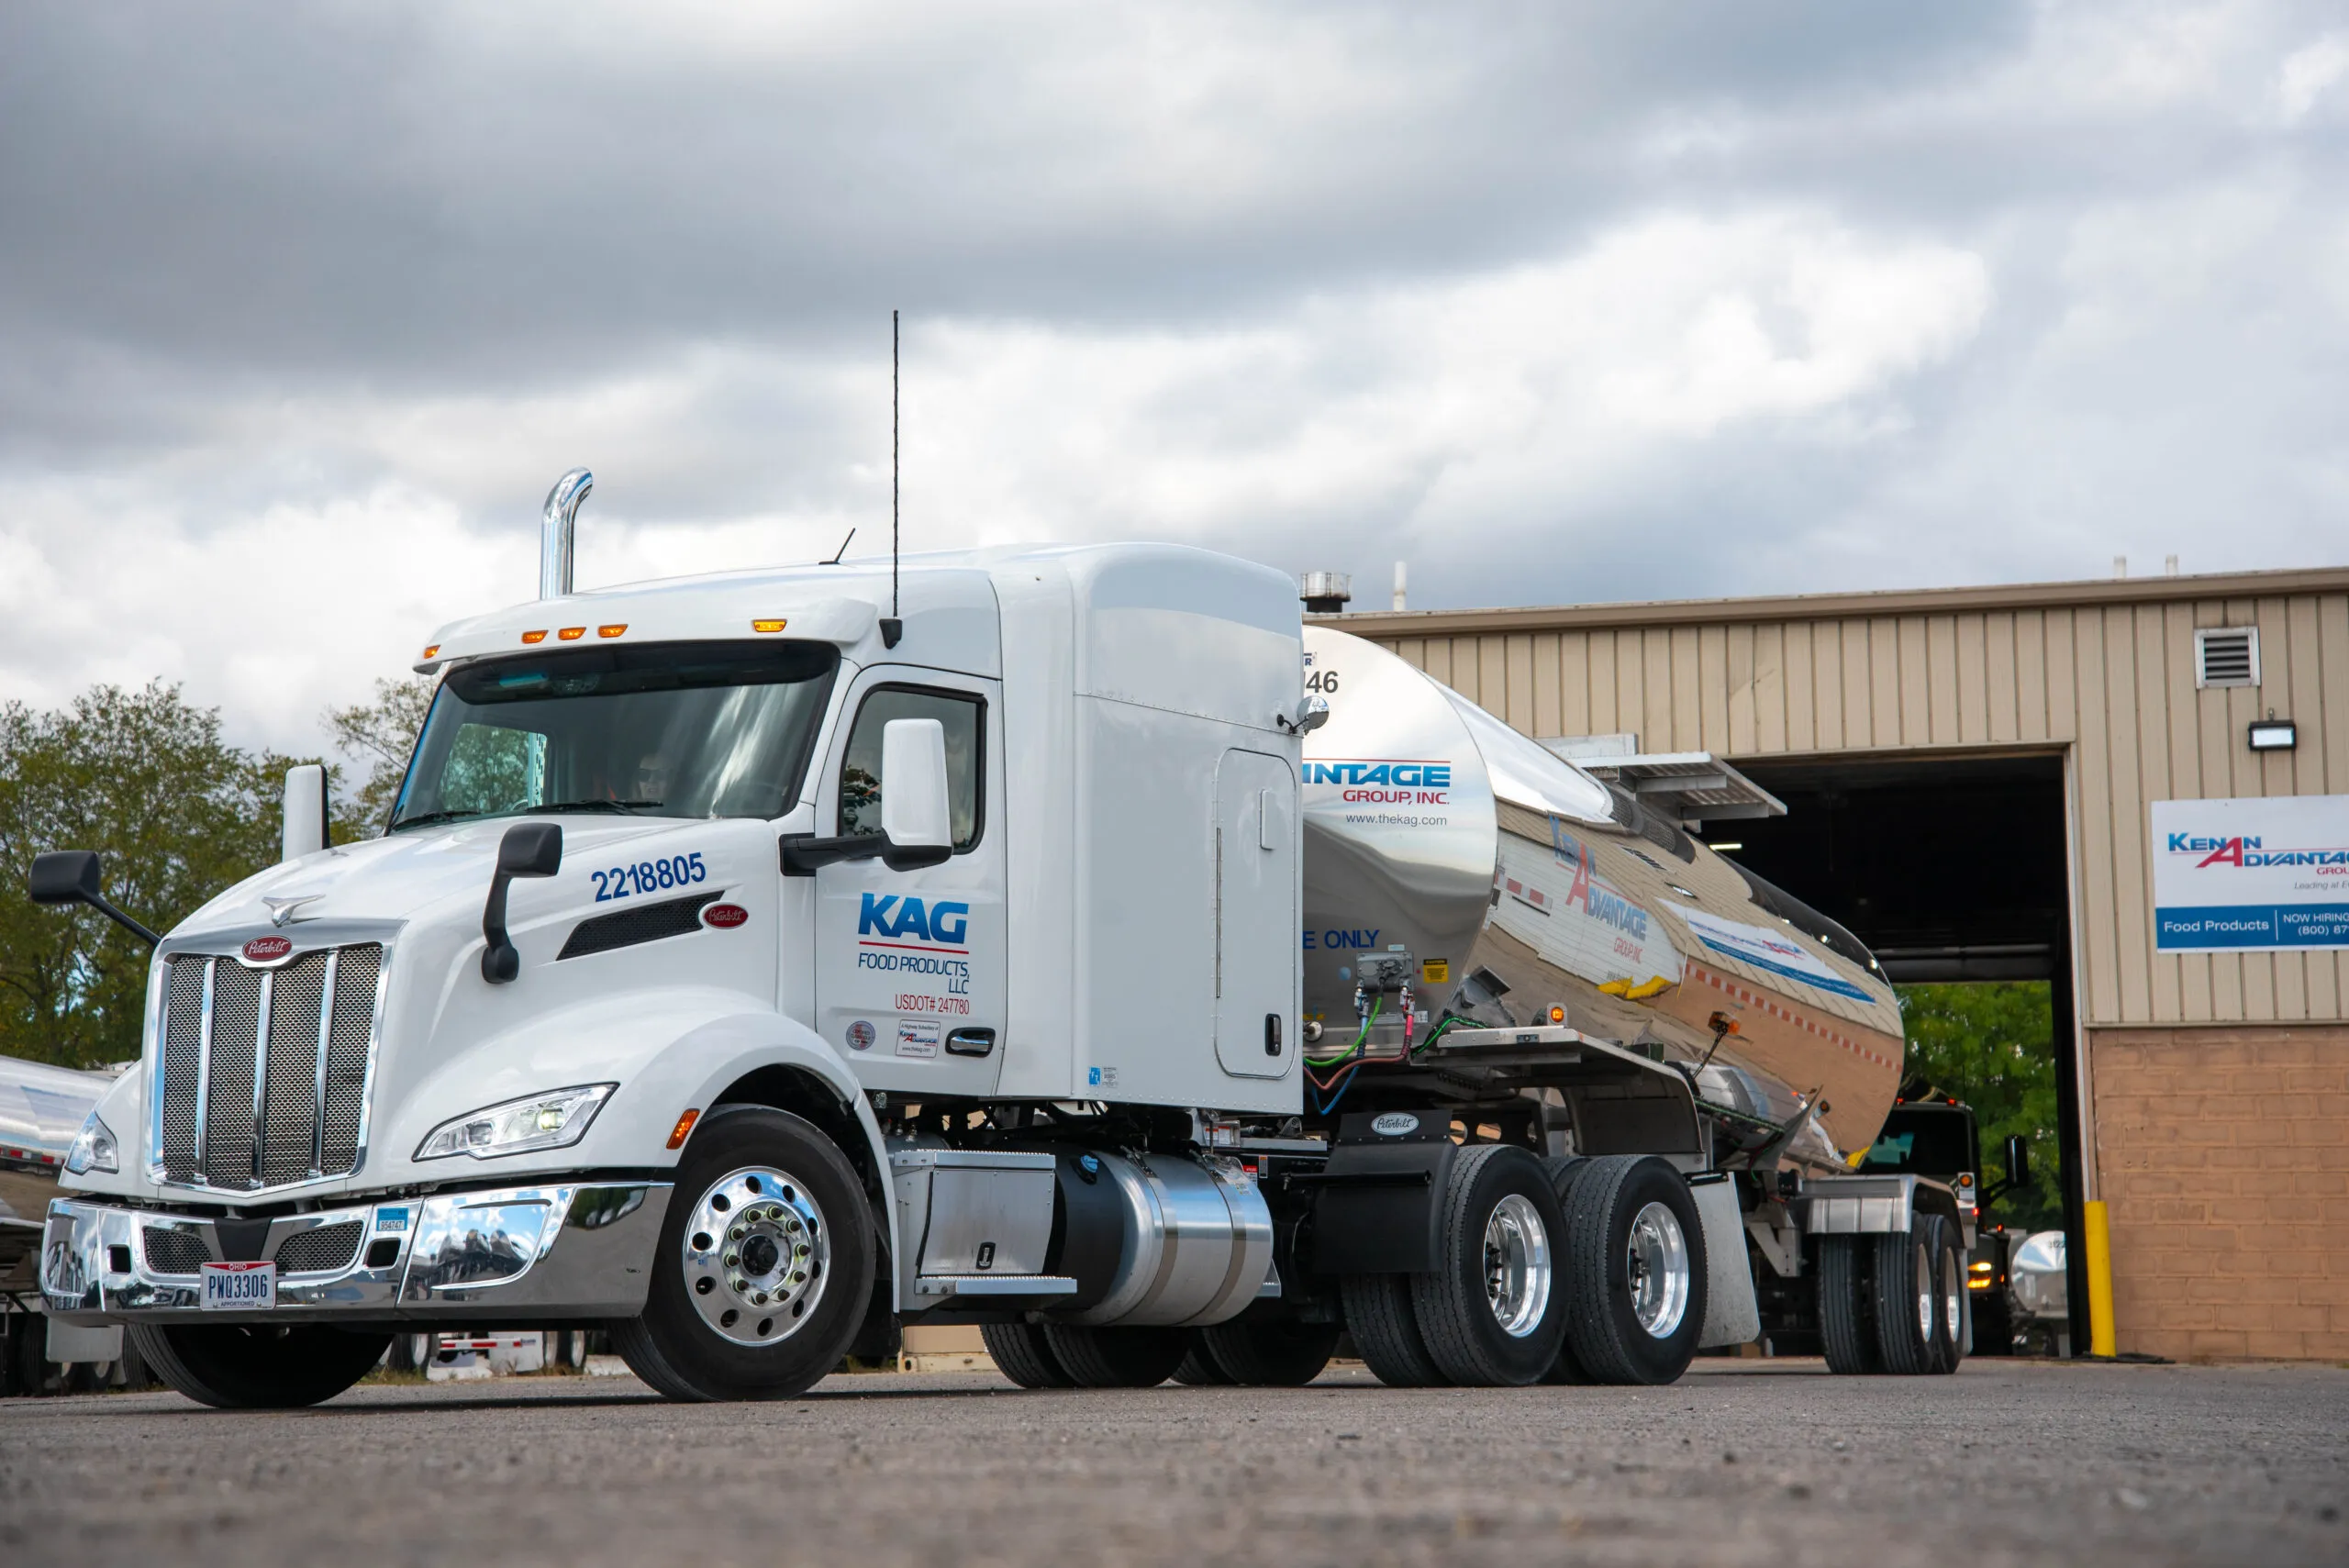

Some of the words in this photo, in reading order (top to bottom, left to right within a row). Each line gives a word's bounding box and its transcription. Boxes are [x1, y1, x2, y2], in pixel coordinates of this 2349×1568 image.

[1303, 763, 1451, 787] NTAGE
[1342, 790, 1412, 806] GROUP,
[1417, 792, 1450, 805] INC.
[1346, 814, 1447, 828] www.thekag.com
[2168, 832, 2262, 853] KENAN
[2195, 837, 2349, 868] ADVANTA
[591, 851, 707, 903] 2218805
[2294, 882, 2328, 891] Leading
[858, 892, 969, 944] KAG
[2164, 921, 2200, 932] Food
[2205, 919, 2269, 931] Products
[2283, 914, 2310, 923] NOW
[1324, 929, 1380, 949] ONLY
[2298, 926, 2329, 936] (800)
[249, 941, 288, 954] Peterbilt
[859, 952, 898, 971] FOOD
[899, 956, 970, 979] PRODUCTS,
[948, 978, 969, 995] LLC
[896, 994, 936, 1012] USDOT#
[938, 997, 970, 1015] 247780
[1377, 1118, 1413, 1129] Peterbilt
[228, 1262, 247, 1271] OHIO
[208, 1273, 268, 1299] PWQ3306
